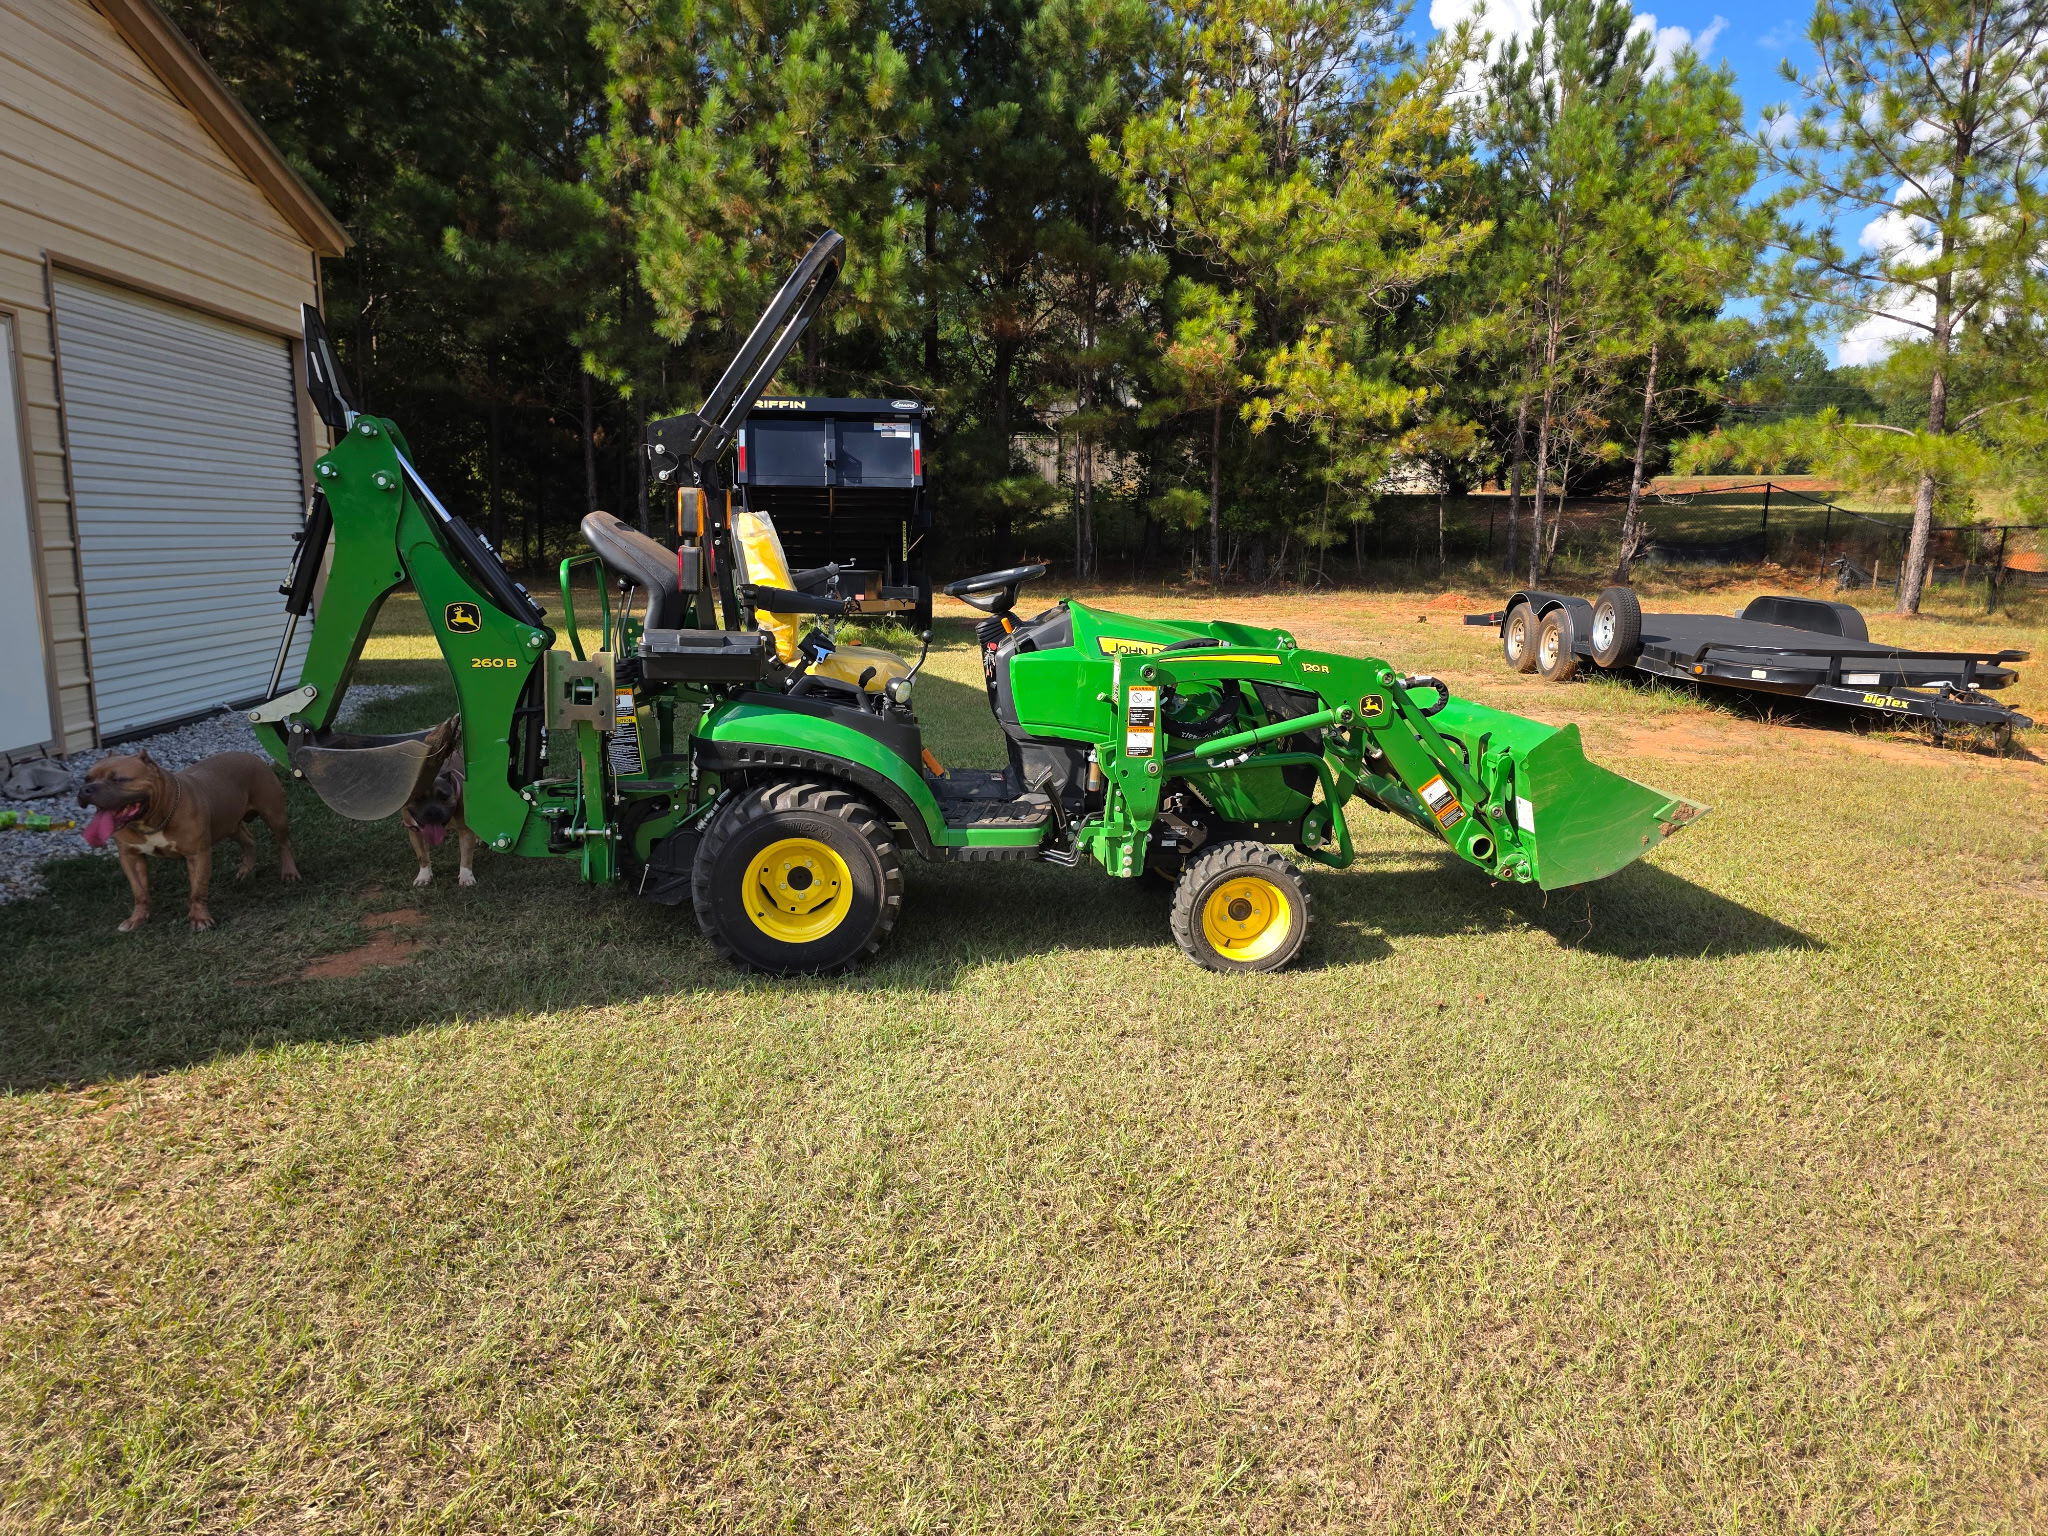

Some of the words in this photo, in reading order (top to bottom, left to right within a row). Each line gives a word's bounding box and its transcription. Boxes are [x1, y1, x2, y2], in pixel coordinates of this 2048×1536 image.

[753, 399, 806, 409] RIFFIN
[1110, 642, 1148, 655] JOHN
[471, 658, 504, 668] 260
[506, 658, 517, 668] B
[1301, 662, 1320, 672] 120
[1321, 665, 1330, 674] R
